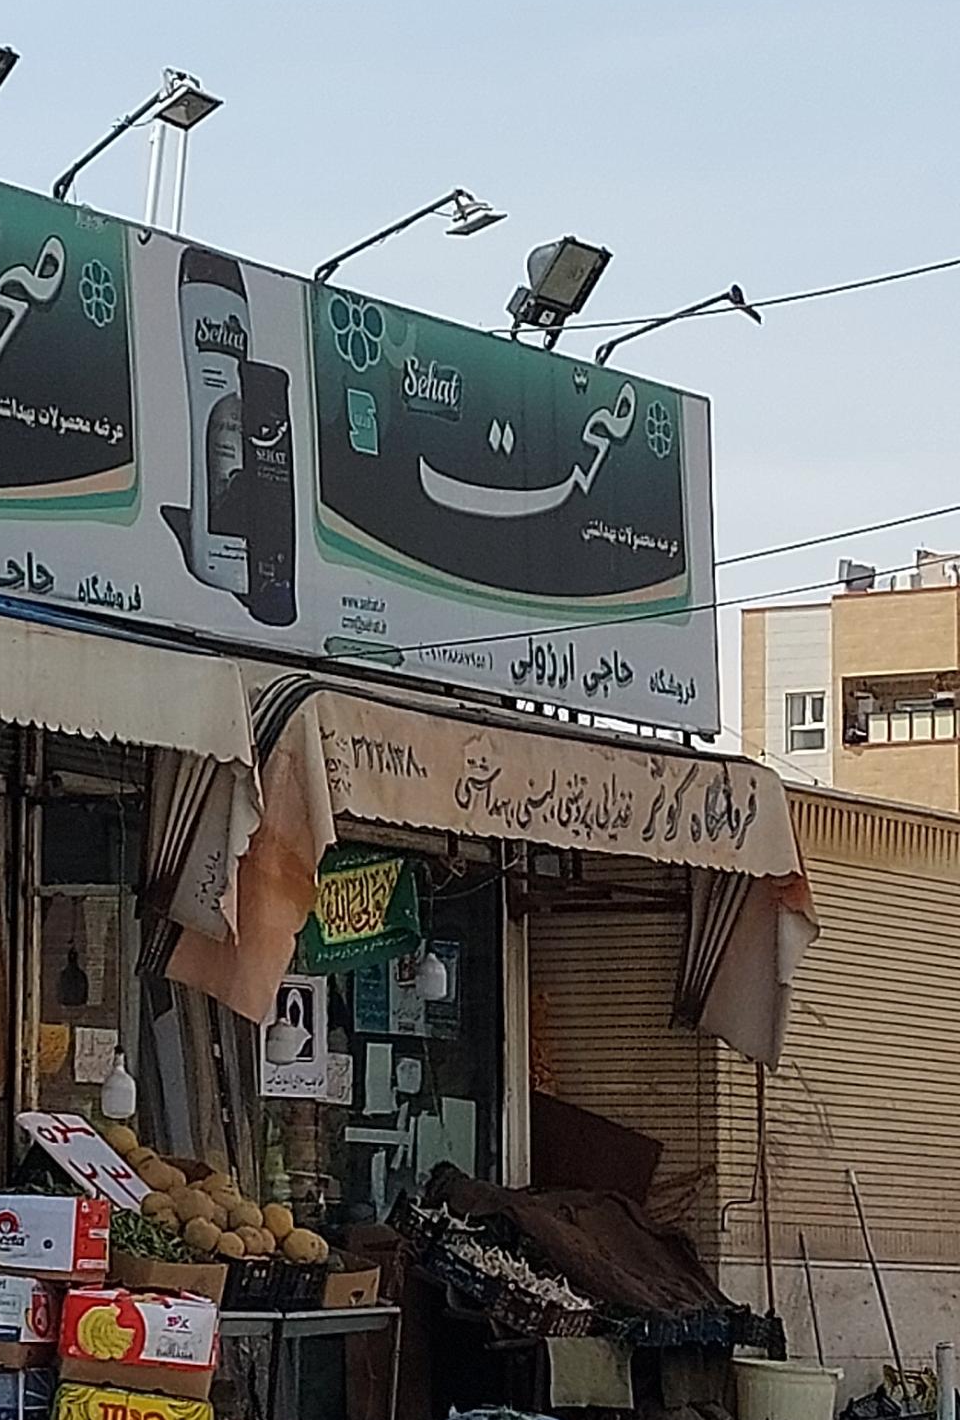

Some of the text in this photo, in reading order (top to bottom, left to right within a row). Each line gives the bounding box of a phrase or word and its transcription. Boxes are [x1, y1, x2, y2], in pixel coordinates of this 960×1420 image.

[404, 357, 460, 407] Sehat
[38, 404, 91, 434] محصولات
[94, 417, 124, 445] عرضه
[78, 573, 141, 611] فروشگاه
[582, 650, 634, 698] حاجی
[650, 668, 696, 705] فروشگاه
[690, 775, 757, 850] فروشگاه
